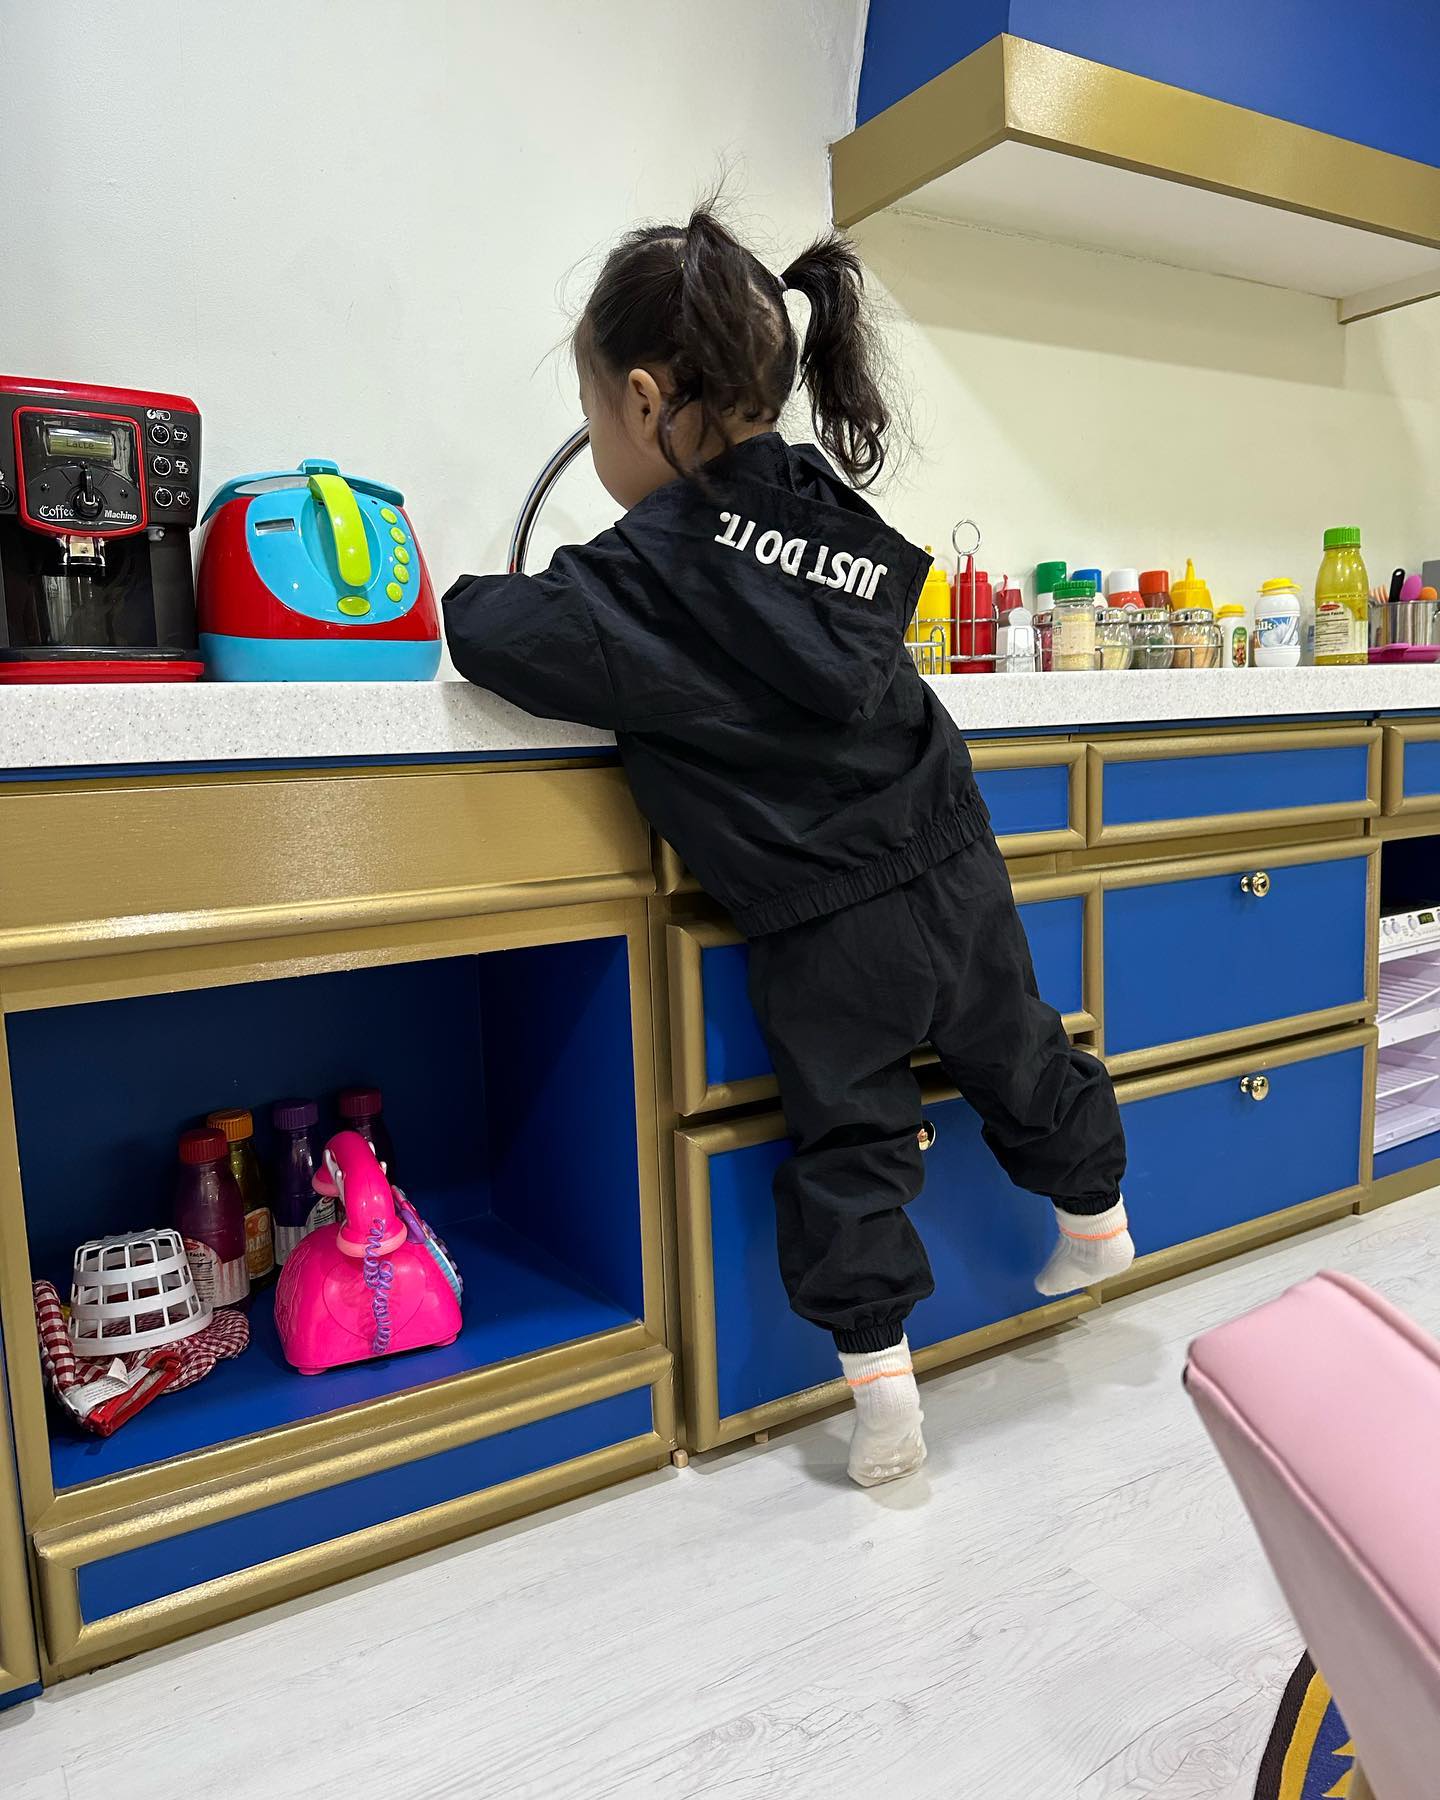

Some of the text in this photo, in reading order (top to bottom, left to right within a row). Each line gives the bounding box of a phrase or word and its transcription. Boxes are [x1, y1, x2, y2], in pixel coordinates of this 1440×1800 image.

[65, 437, 95, 450] Latte
[39, 503, 138, 521] Coffee Machine
[714, 511, 889, 600] JUST DO IT.
